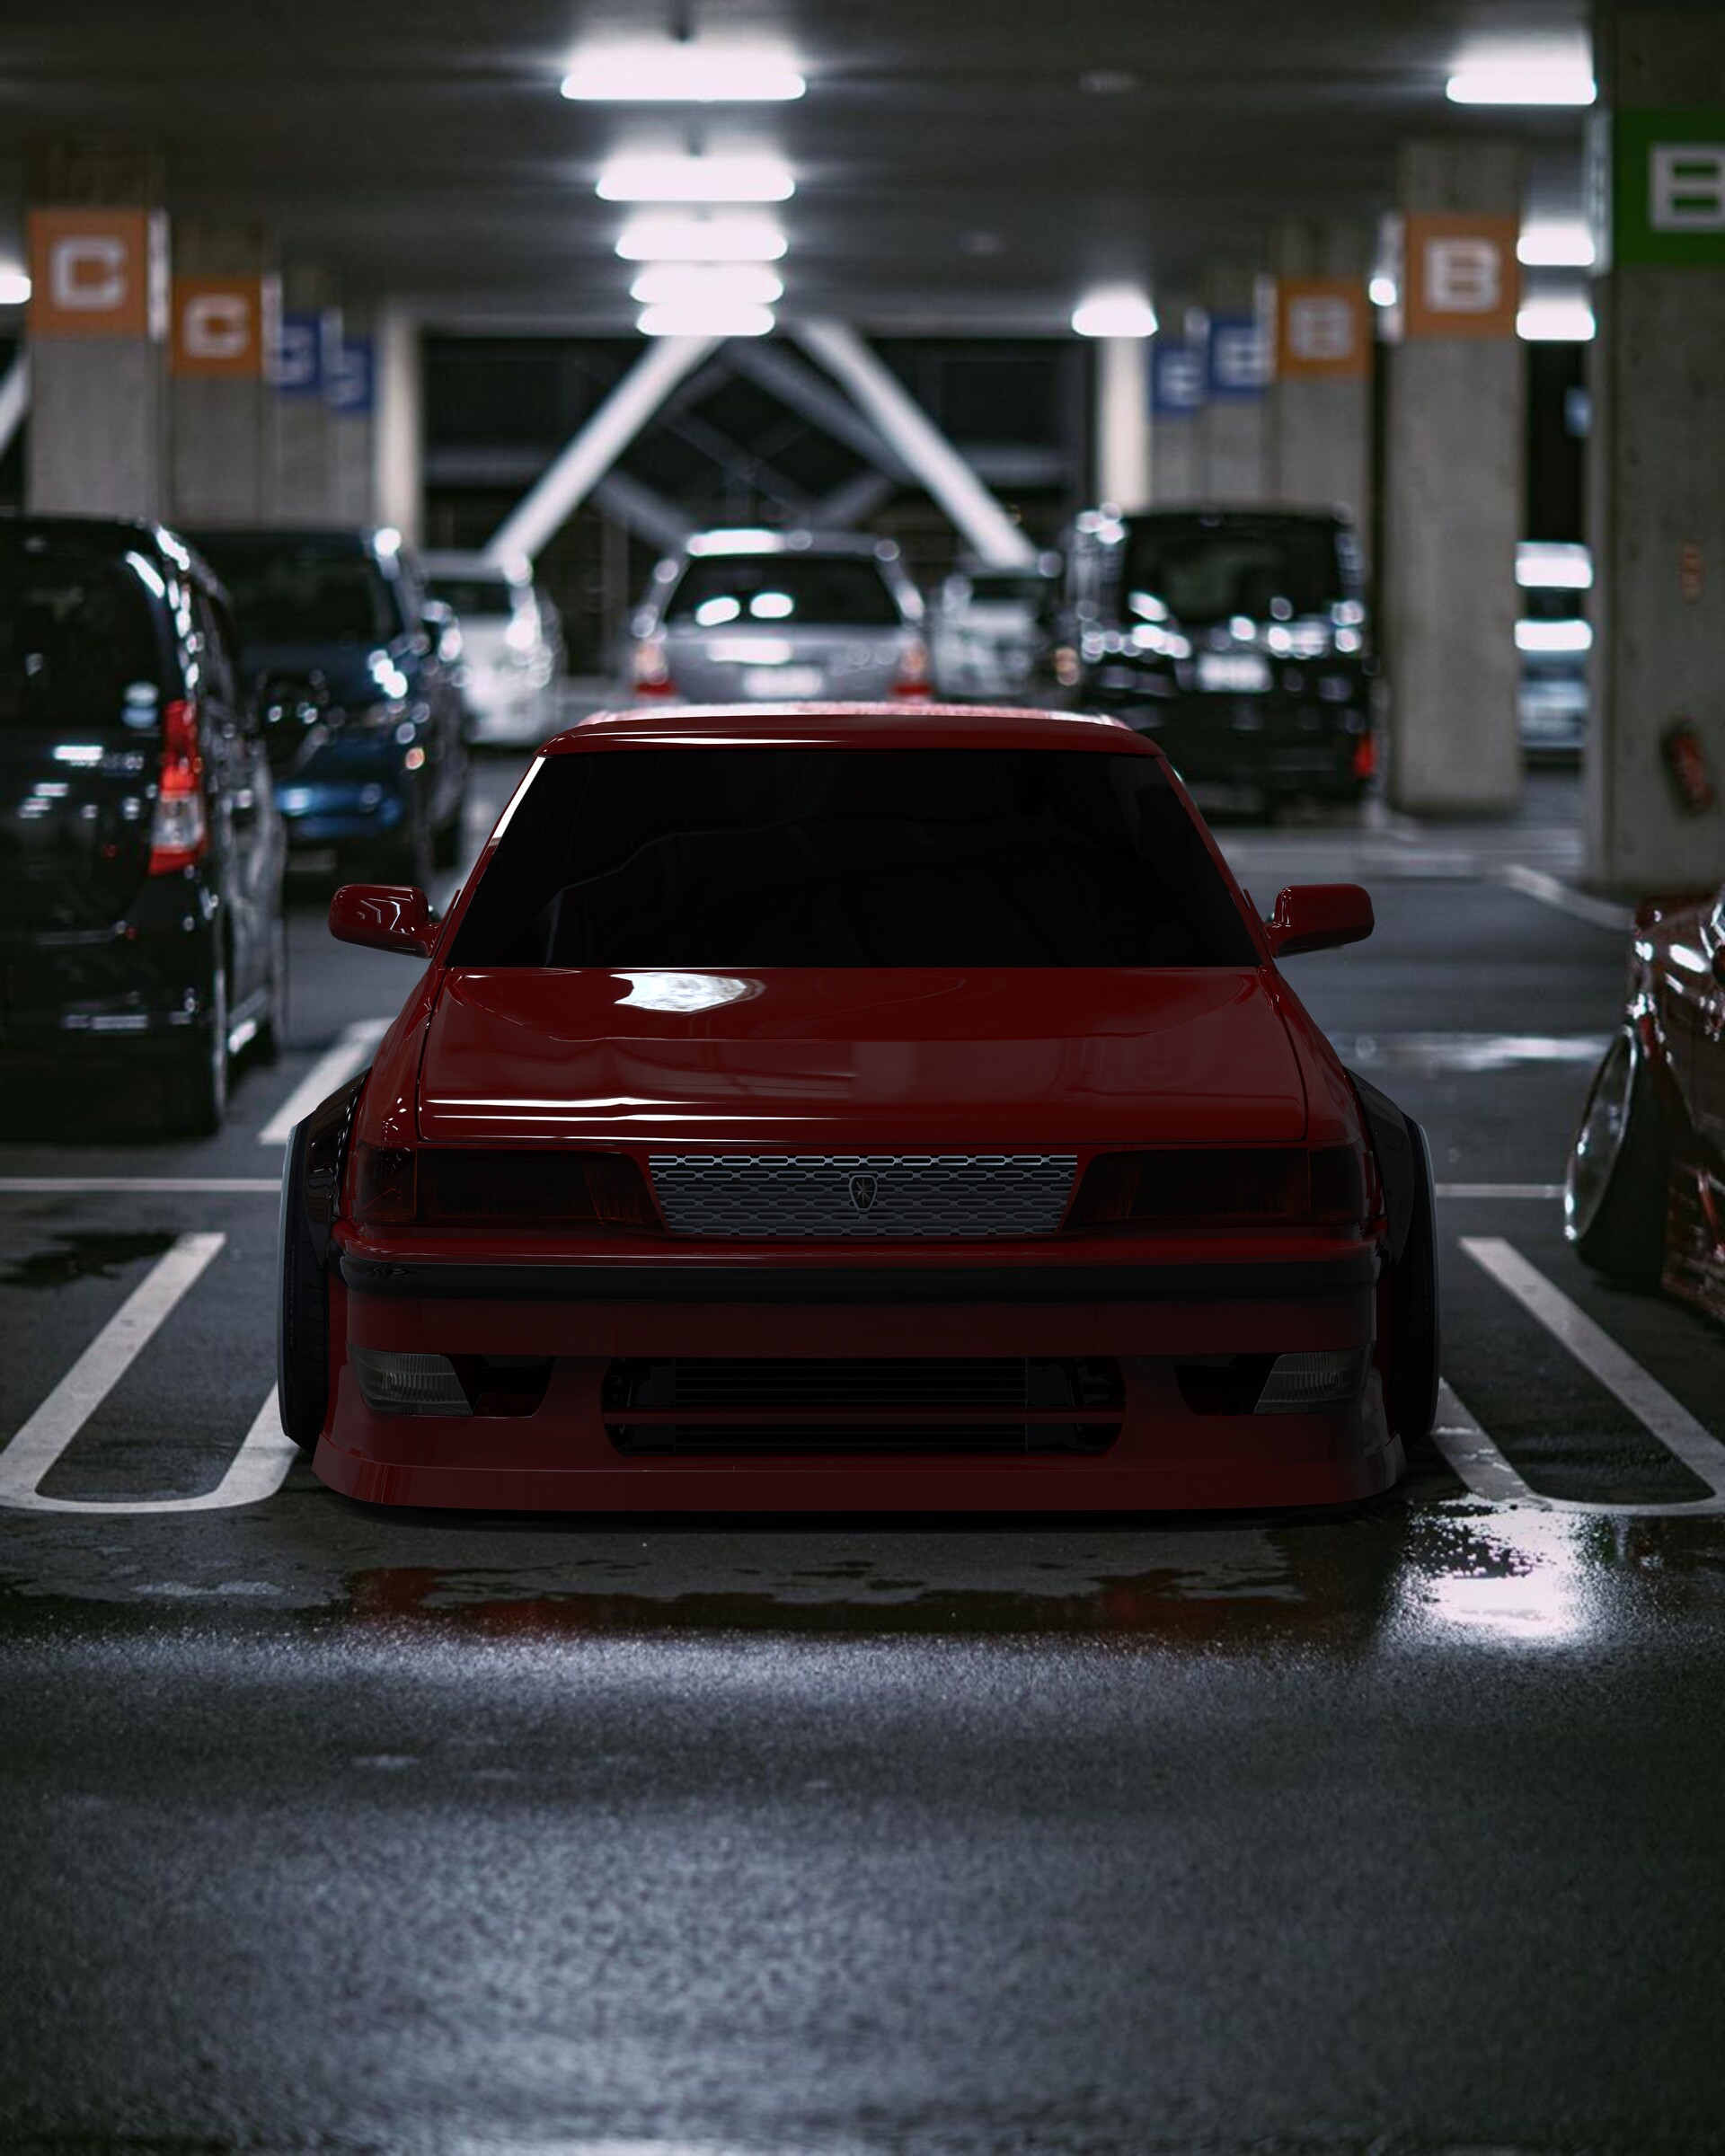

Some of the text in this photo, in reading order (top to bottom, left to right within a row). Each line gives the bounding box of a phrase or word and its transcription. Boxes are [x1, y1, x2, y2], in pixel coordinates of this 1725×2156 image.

[1650, 143, 1725, 233] B
[50, 237, 128, 311] C
[1425, 236, 1501, 313] B
[184, 294, 251, 358] C
